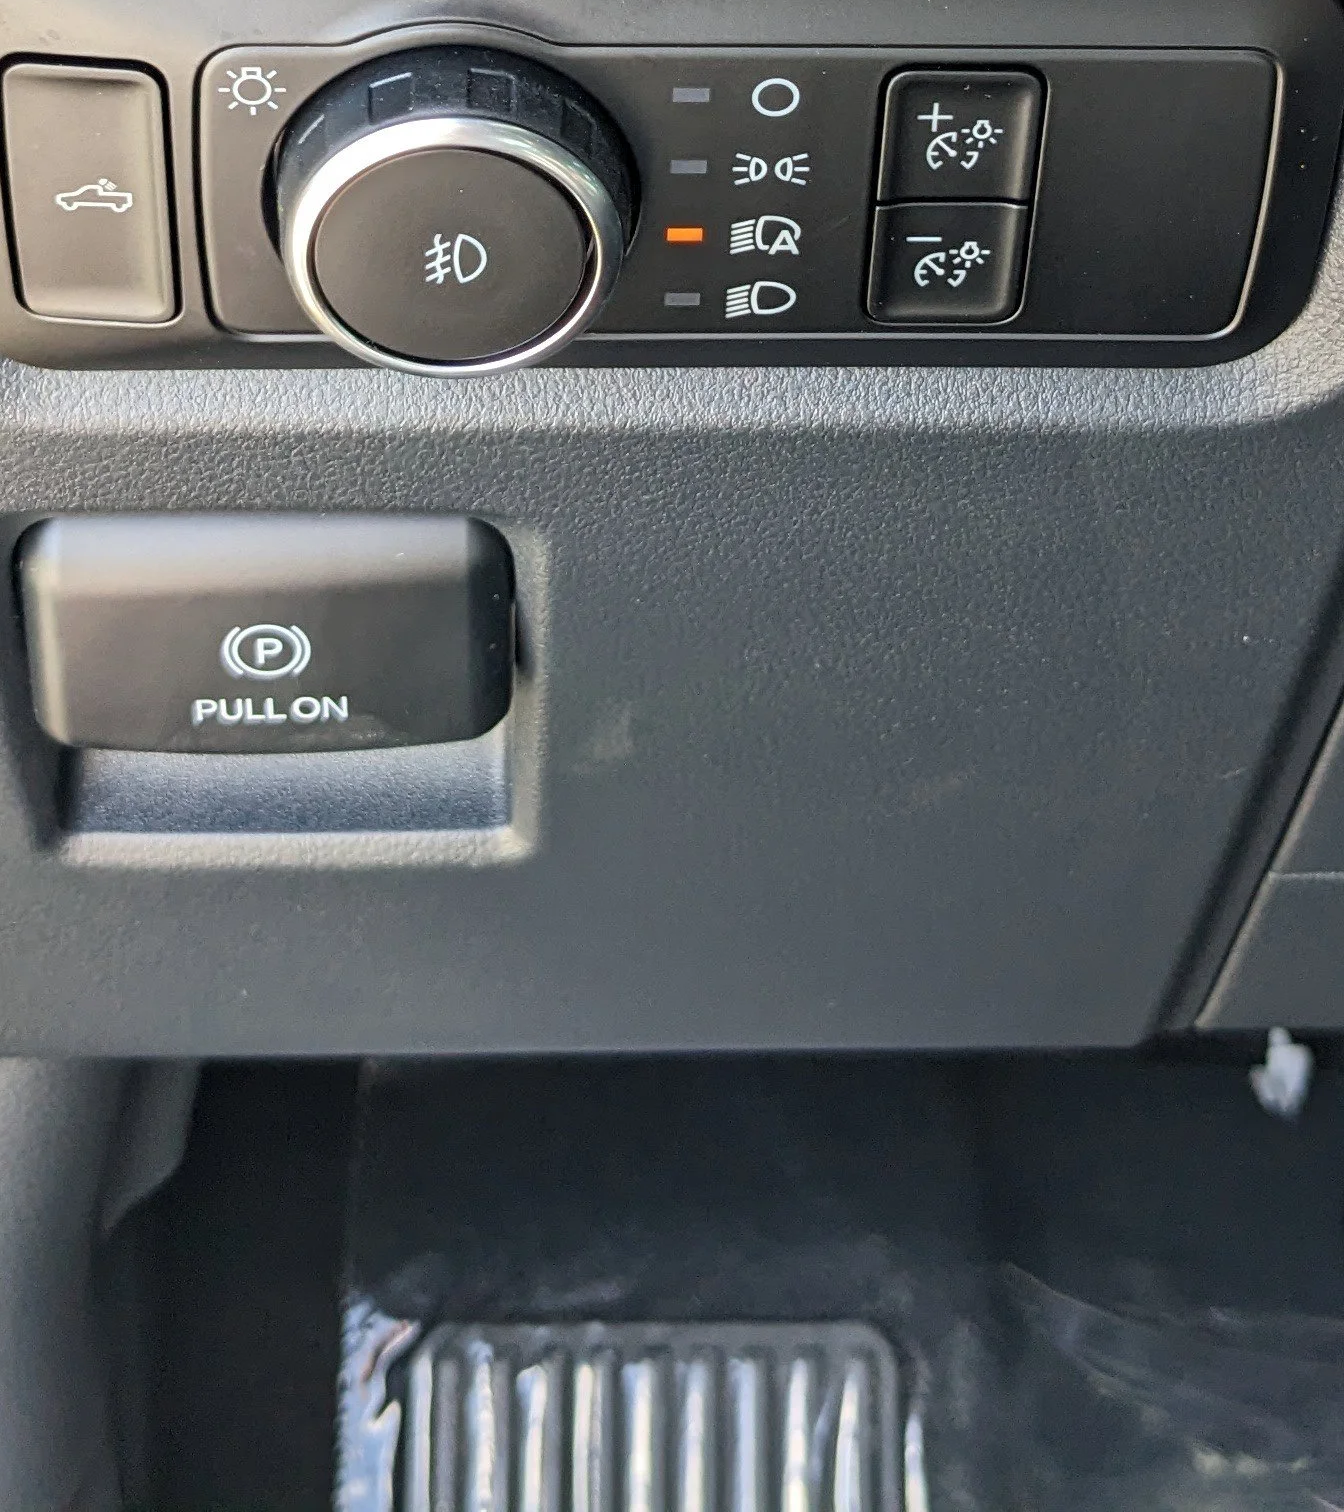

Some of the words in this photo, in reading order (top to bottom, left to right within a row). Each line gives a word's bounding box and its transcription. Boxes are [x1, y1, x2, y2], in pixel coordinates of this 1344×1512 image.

[255, 637, 283, 666] P
[191, 697, 288, 727] PULL
[289, 695, 349, 724] ON
